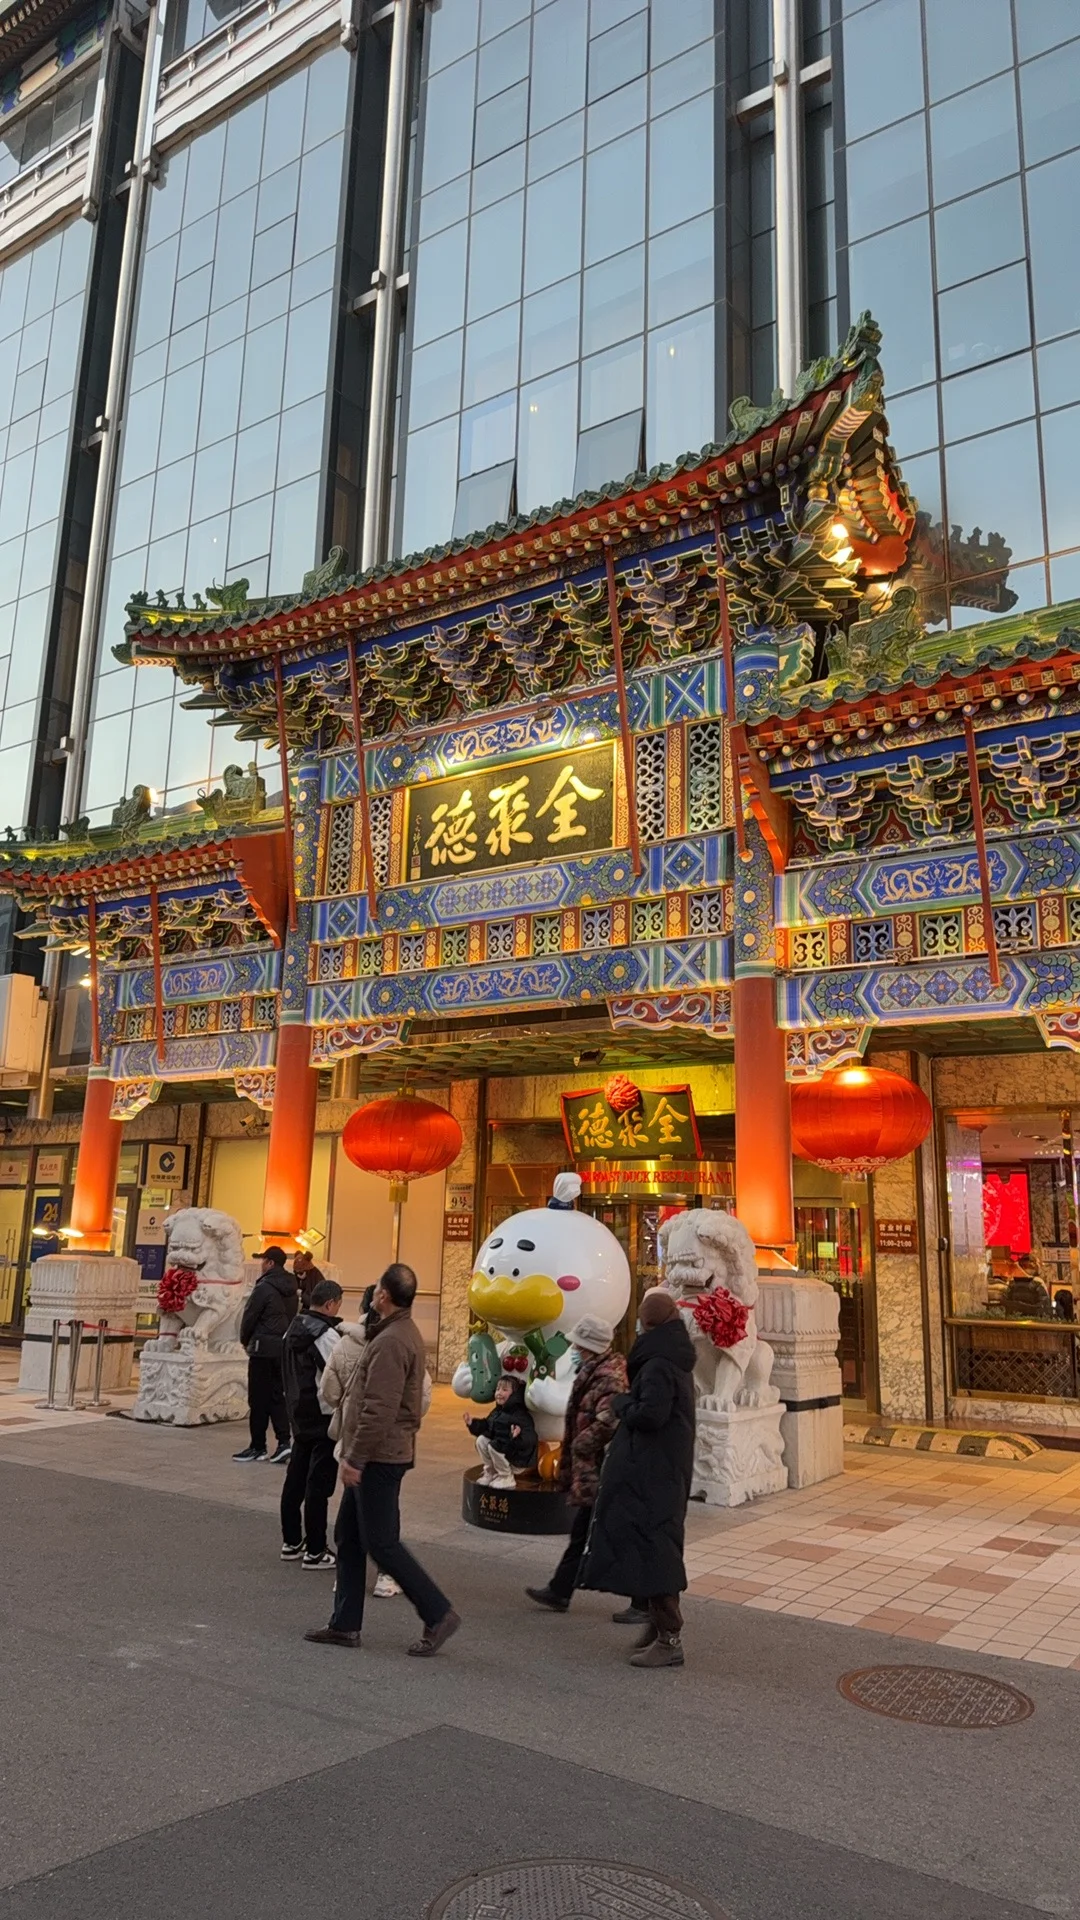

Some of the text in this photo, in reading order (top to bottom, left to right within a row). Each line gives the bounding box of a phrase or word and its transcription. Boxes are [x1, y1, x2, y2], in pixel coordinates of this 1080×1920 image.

[424, 765, 606, 866] 全聚德
[623, 1171, 650, 1183] DUCK
[652, 1170, 732, 1184] RESTAURANT
[42, 1203, 58, 1221] 24
[879, 1224, 911, 1232] 营业时间
